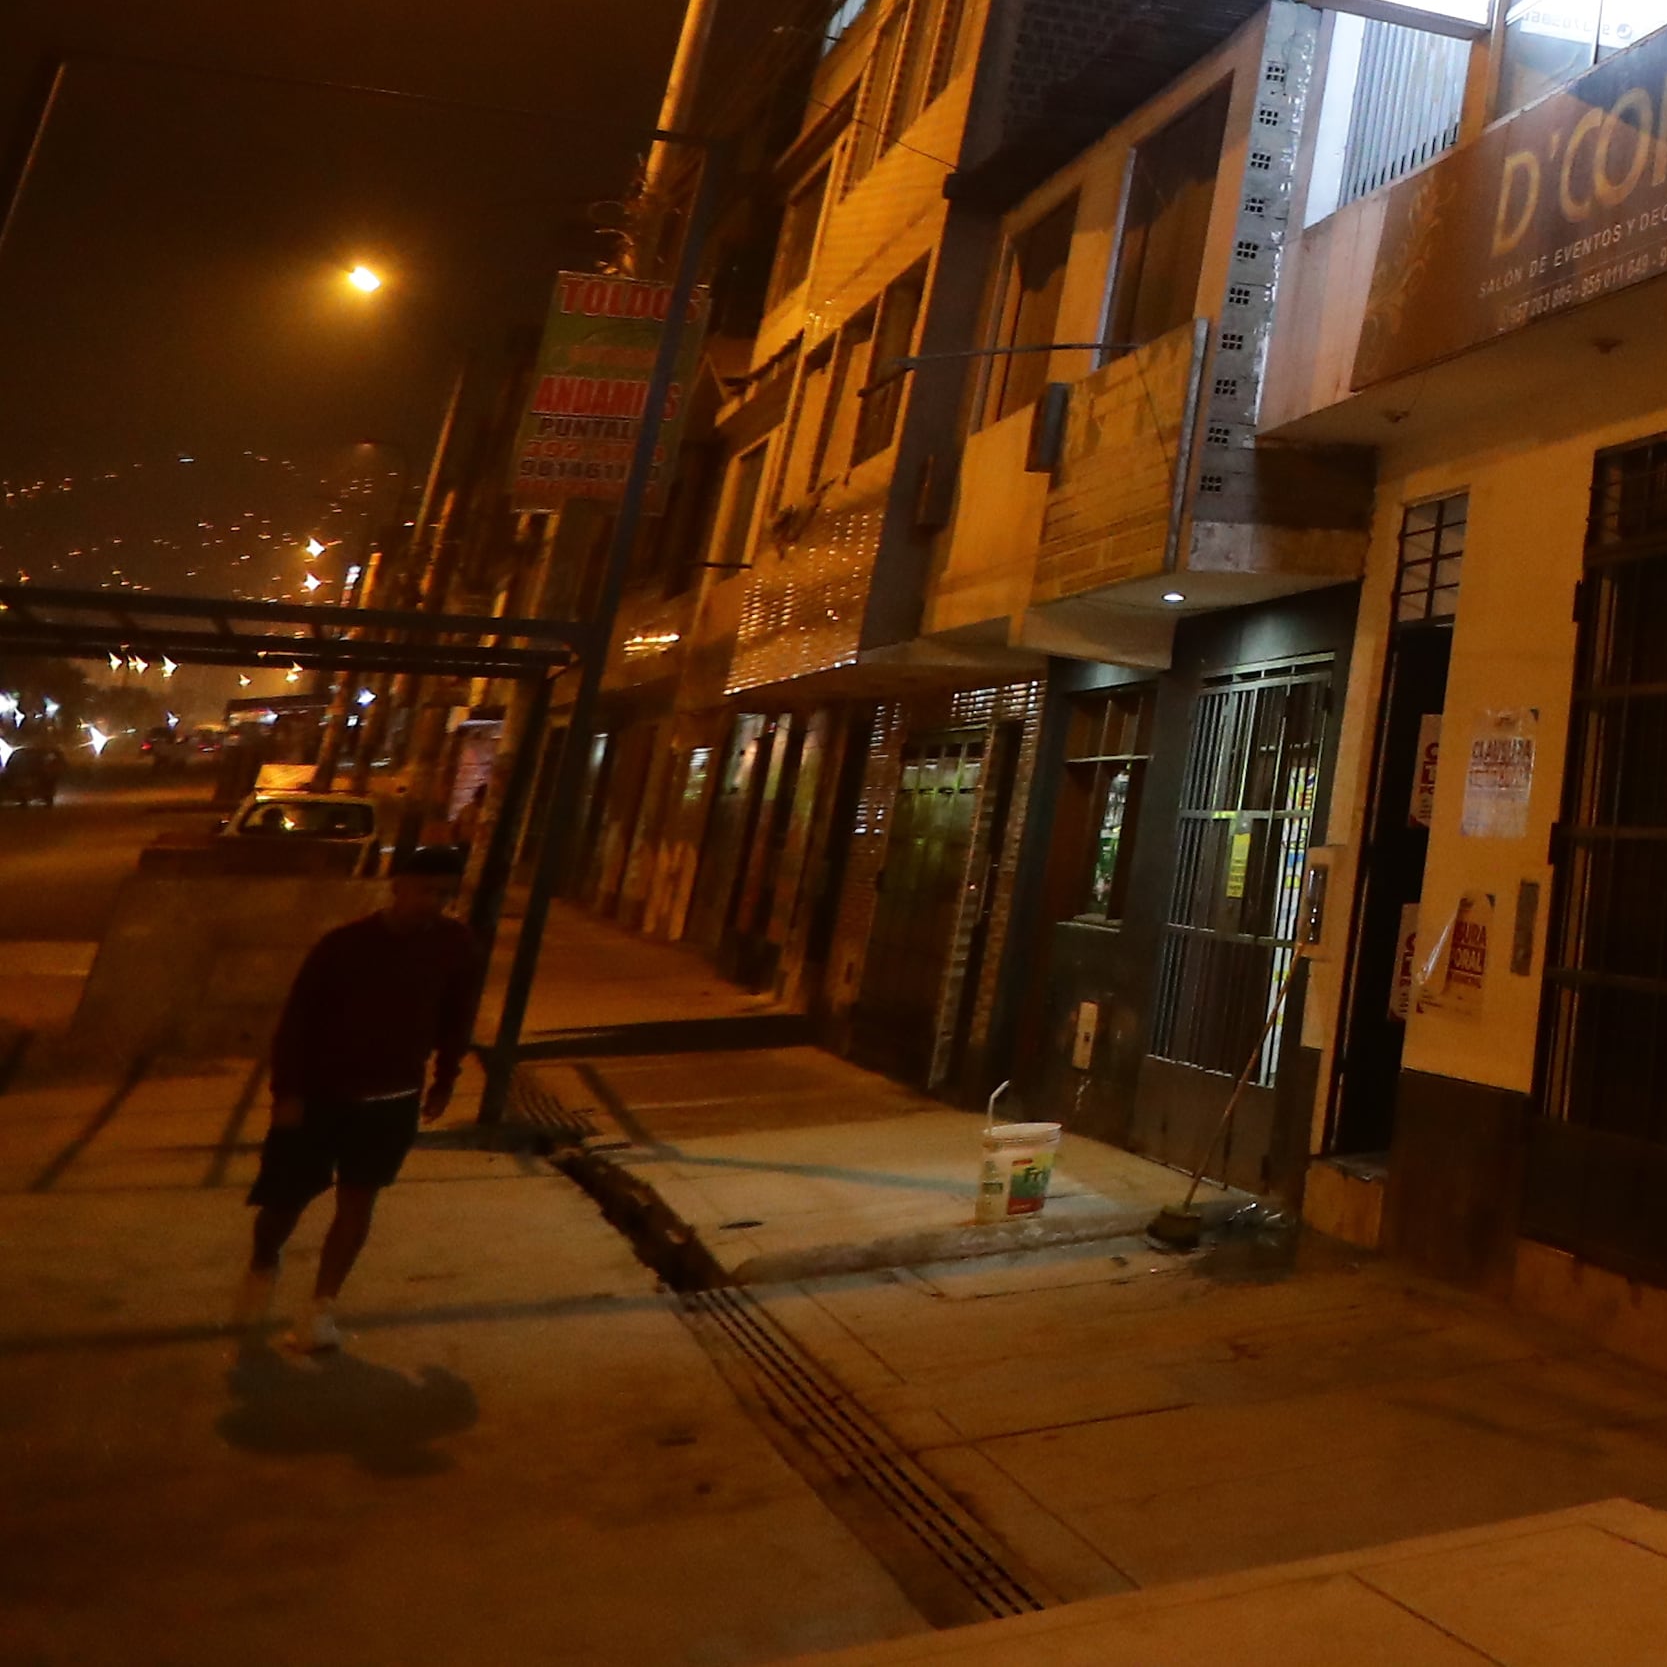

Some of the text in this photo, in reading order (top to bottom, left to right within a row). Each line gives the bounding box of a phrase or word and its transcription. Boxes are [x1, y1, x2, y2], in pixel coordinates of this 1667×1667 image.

[1478, 266, 1523, 298] SALON
[1529, 254, 1549, 279] DE
[1554, 223, 1621, 268] EVENTOS
[1627, 218, 1636, 236] Y
